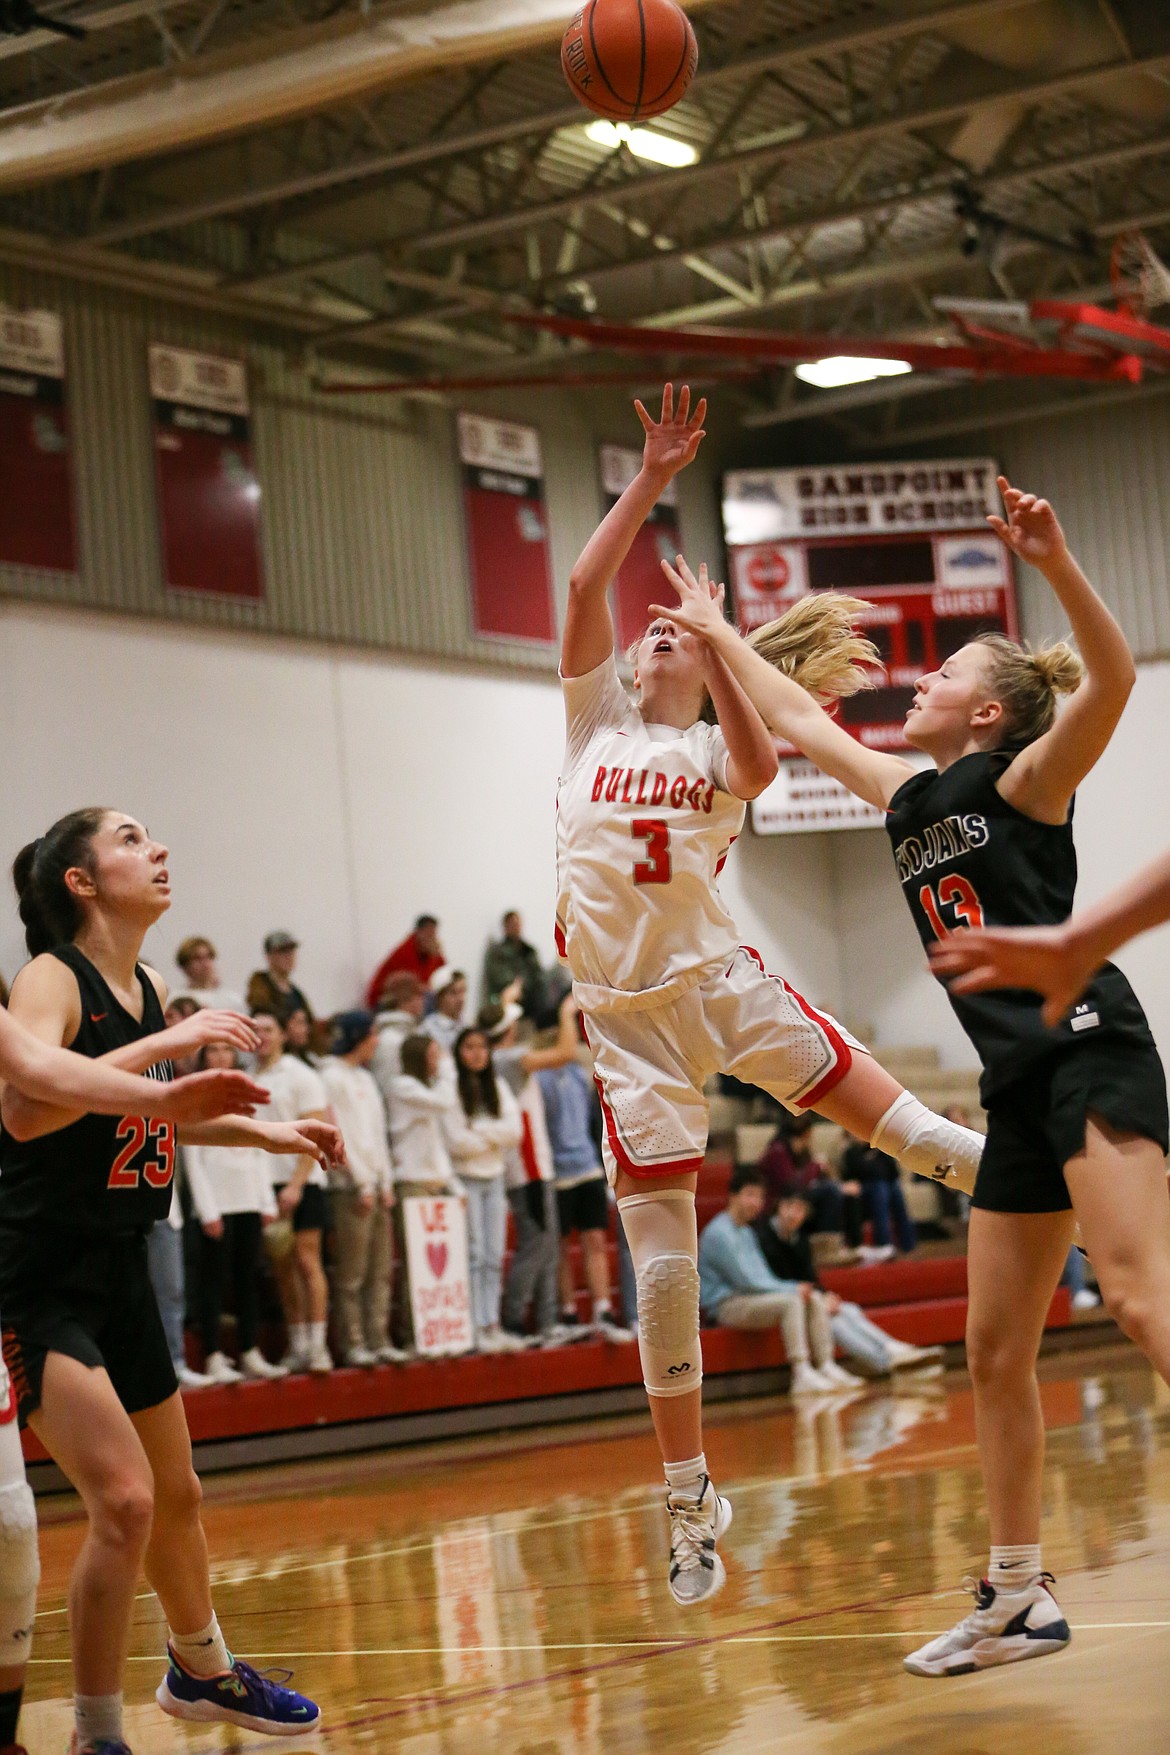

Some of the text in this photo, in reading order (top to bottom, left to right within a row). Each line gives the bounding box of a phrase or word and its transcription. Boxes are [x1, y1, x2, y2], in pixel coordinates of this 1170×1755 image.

[797, 467, 986, 499] SANDPOINT
[803, 504, 870, 526] HIGH
[931, 590, 999, 617] GUEST
[590, 765, 715, 814] BULLDOGS
[630, 818, 672, 886] 3
[919, 872, 984, 945] 13
[107, 1114, 176, 1189] 23
